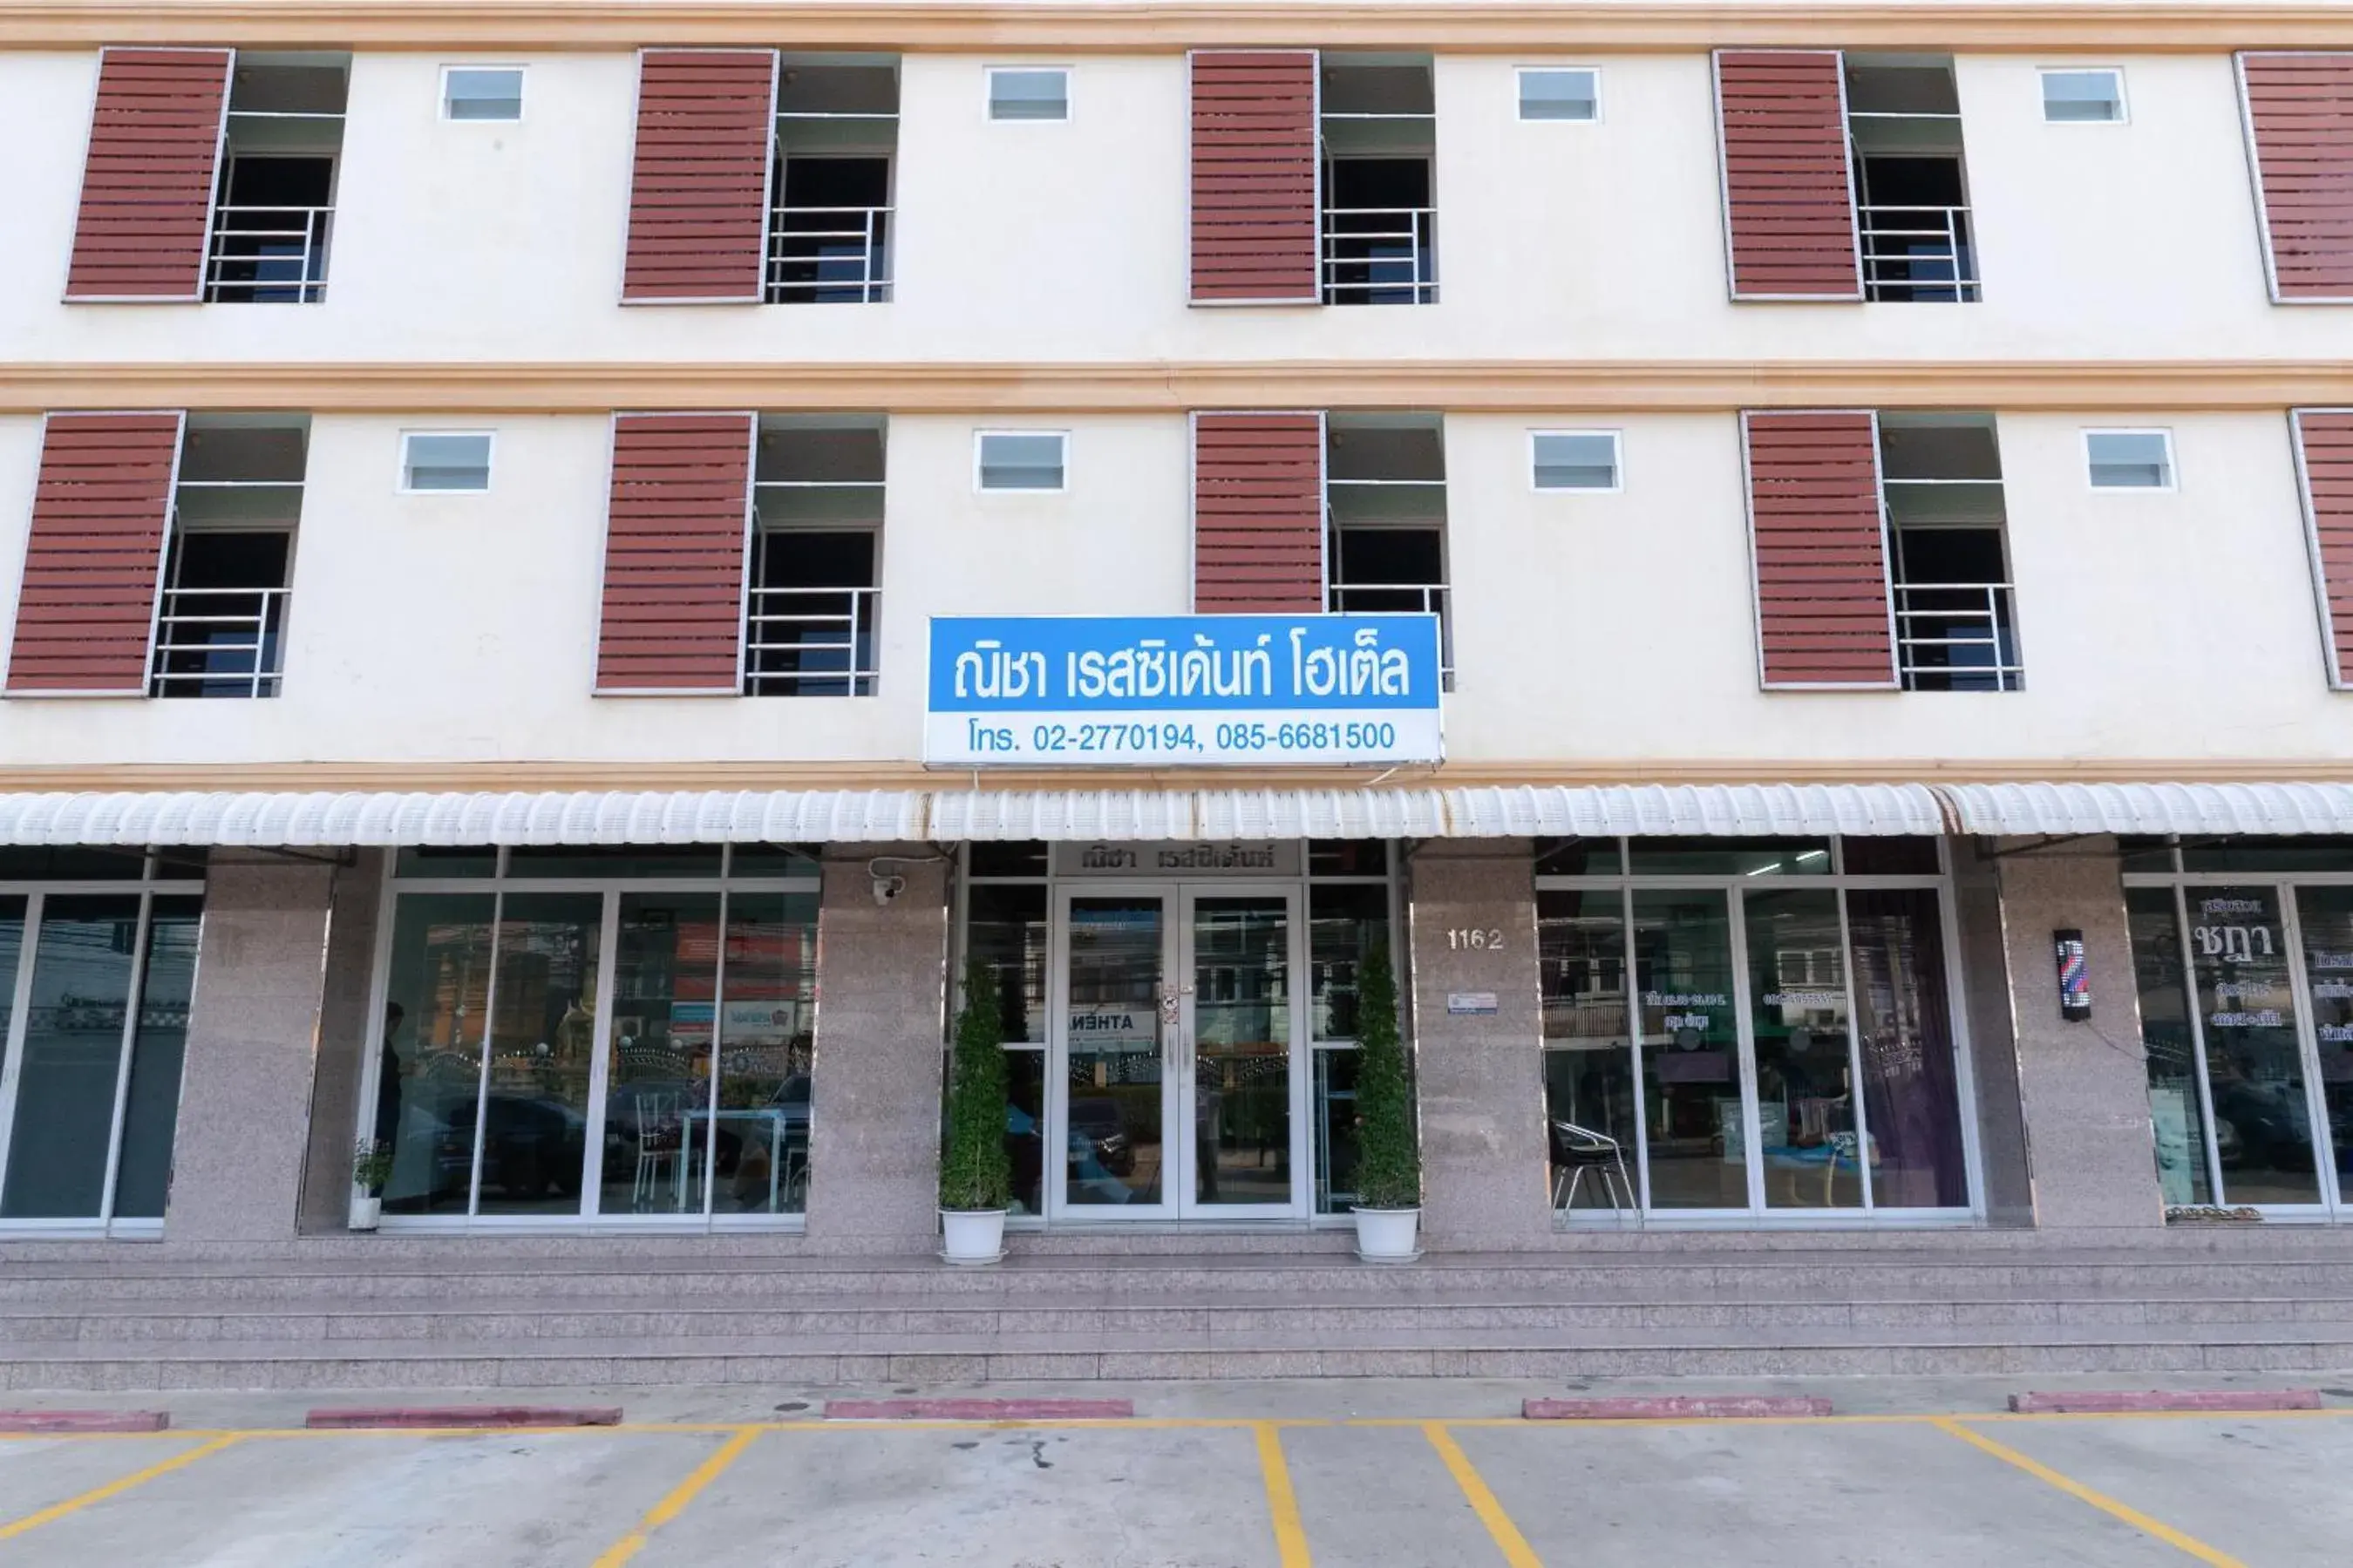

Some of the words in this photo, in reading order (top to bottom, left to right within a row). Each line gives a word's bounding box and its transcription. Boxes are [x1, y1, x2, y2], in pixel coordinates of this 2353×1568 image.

[955, 640, 1046, 698] ณิชา
[1067, 633, 1271, 698] เรสซิเด้นท์
[1289, 627, 1410, 696] โฮเต็ล
[969, 718, 1021, 751] โทร.
[1033, 723, 1205, 753] 02-2770194,
[1216, 722, 1395, 750] 085-6681500
[1447, 928, 1504, 950] 1162
